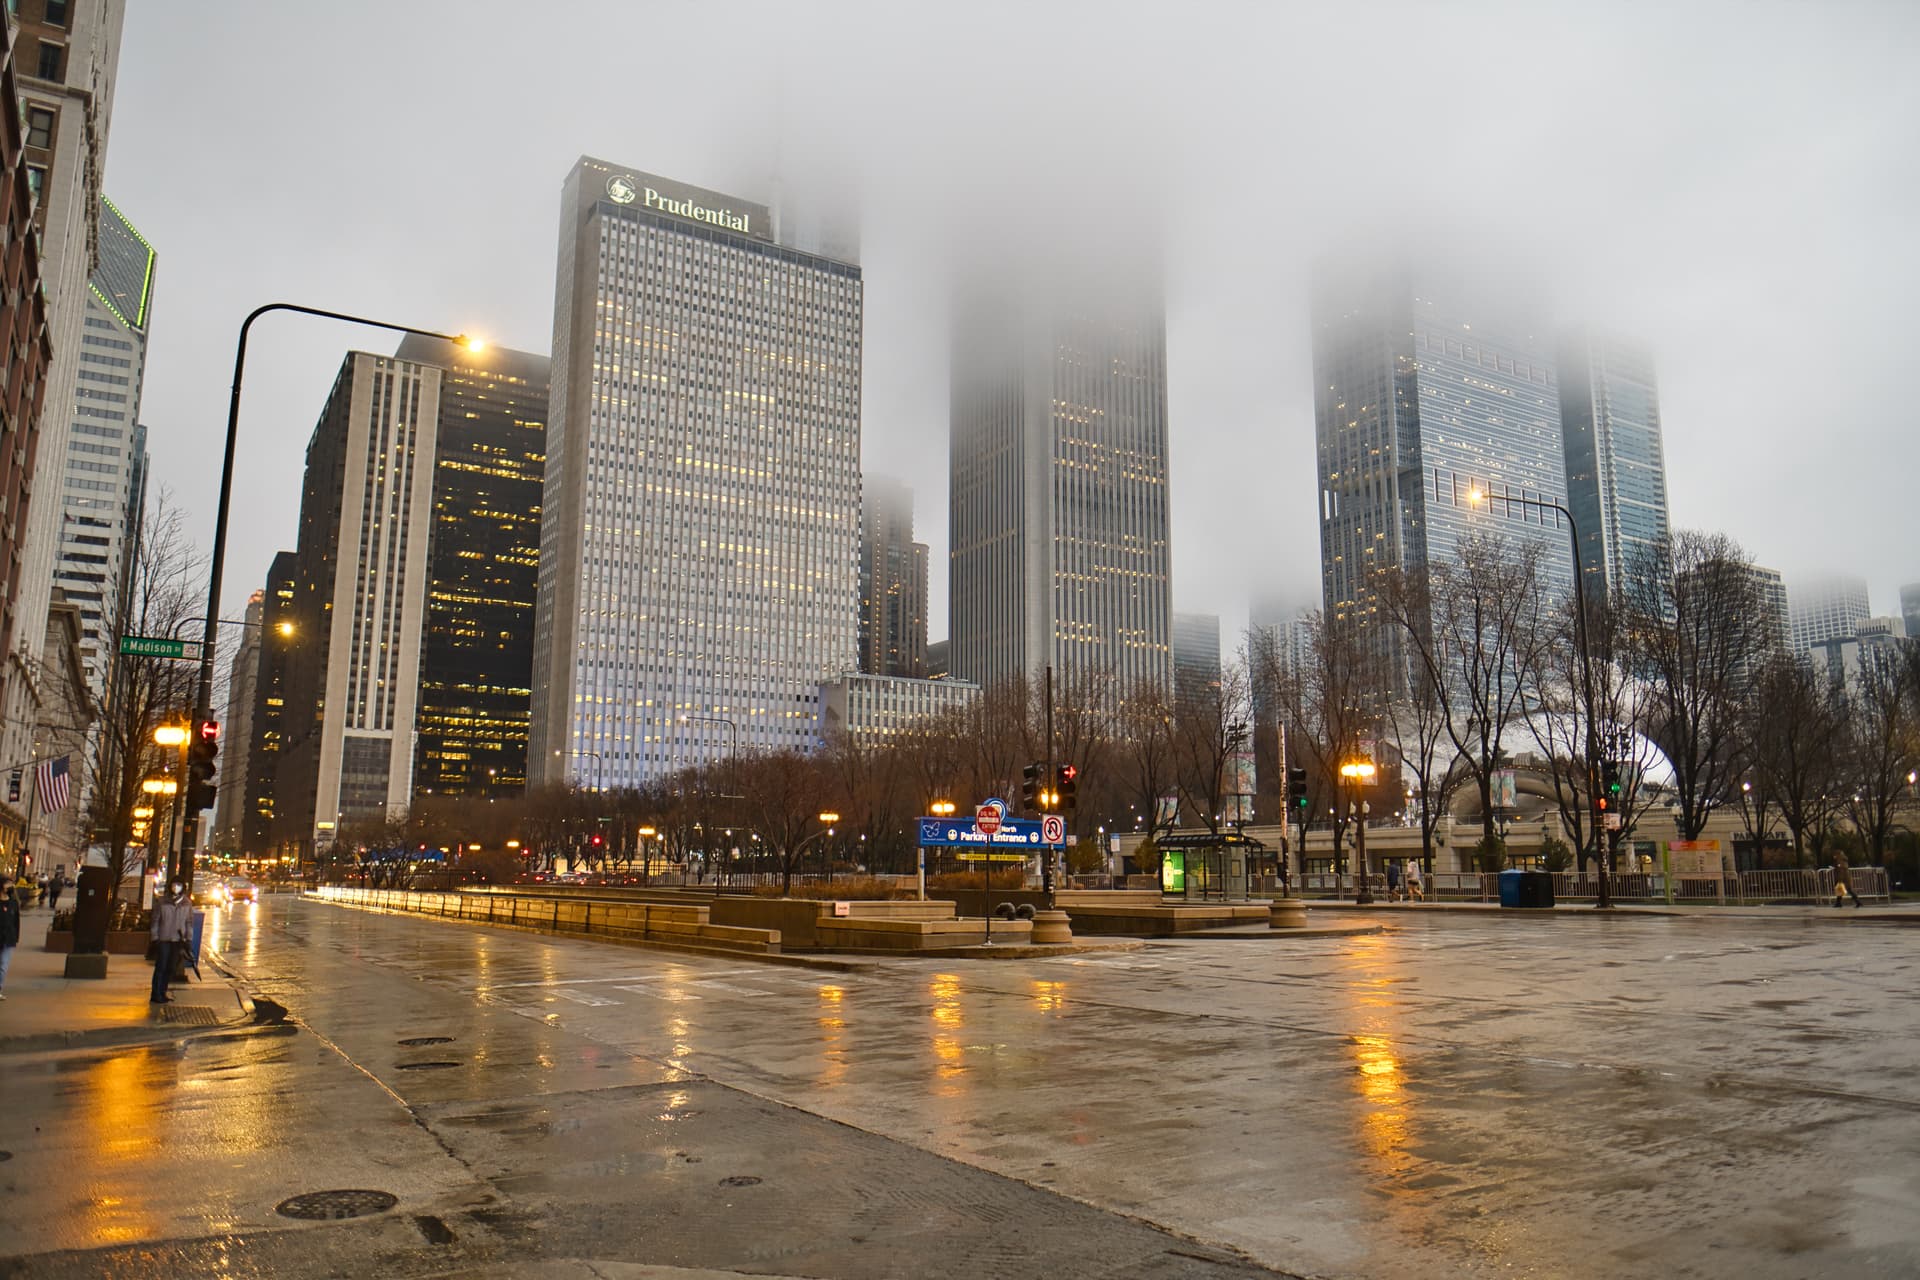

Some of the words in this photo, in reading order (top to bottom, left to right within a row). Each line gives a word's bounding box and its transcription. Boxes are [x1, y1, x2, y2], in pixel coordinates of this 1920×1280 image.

[643, 187, 749, 232] Prudential
[130, 640, 172, 653] Madison
[993, 833, 1027, 843] Entrance
